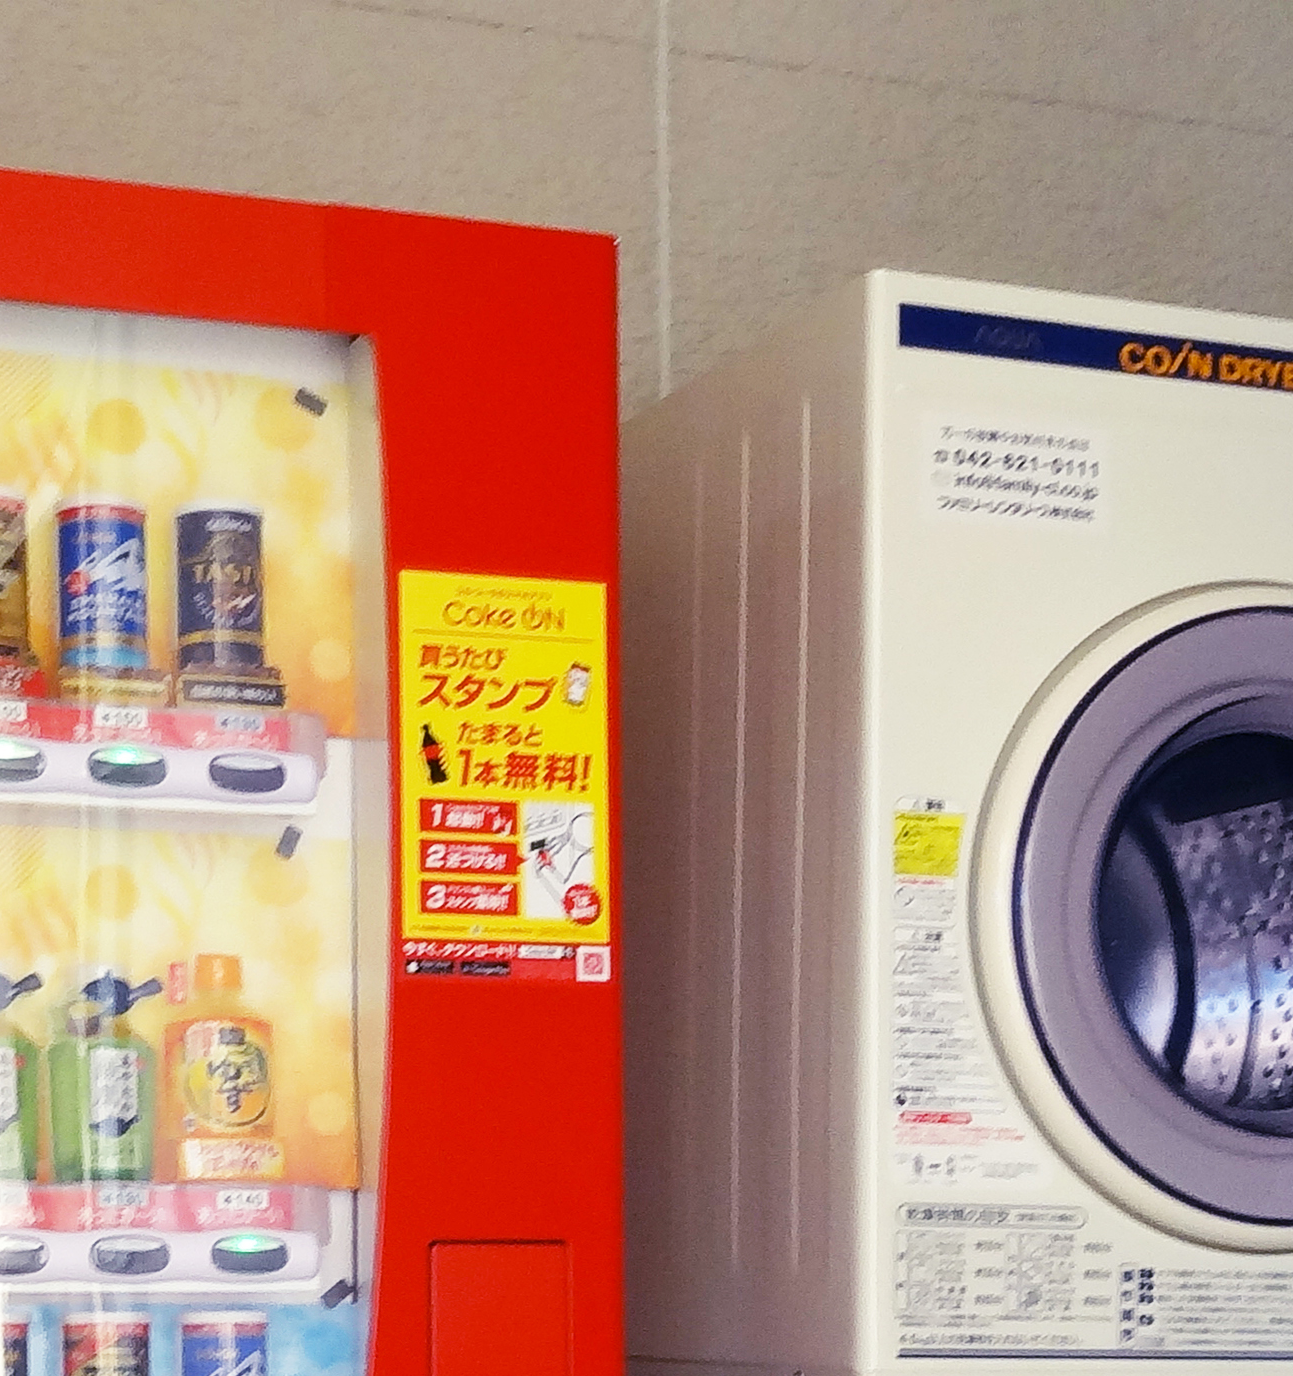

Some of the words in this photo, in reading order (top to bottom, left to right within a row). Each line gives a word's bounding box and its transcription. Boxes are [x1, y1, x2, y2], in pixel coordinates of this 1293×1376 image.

[442, 600, 517, 630] Coke
[418, 643, 508, 672] 買うたび
[417, 672, 558, 713] スタンプ
[457, 721, 544, 748] たまると
